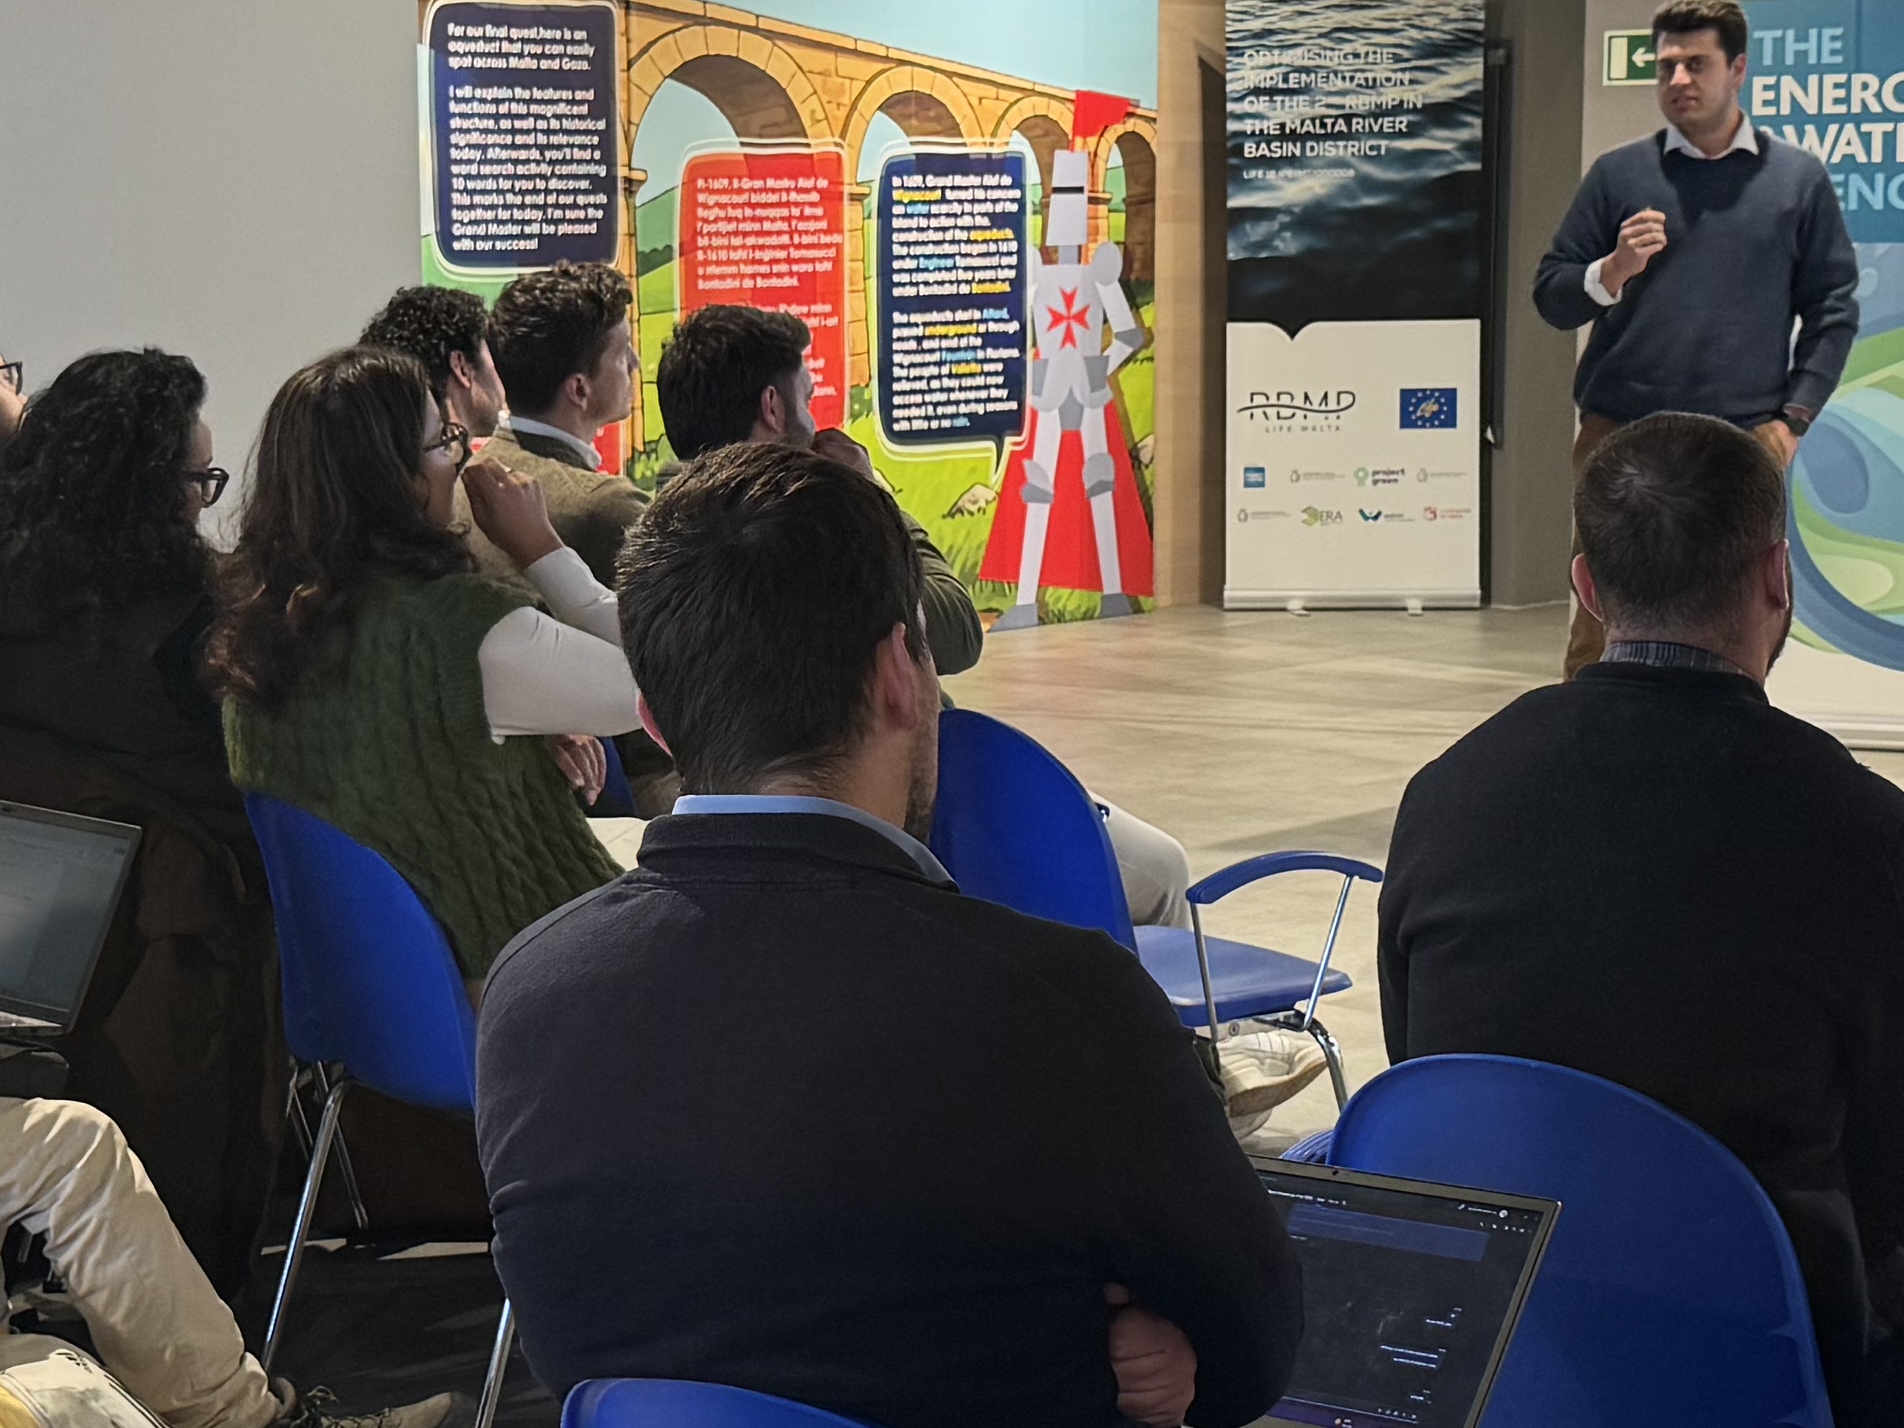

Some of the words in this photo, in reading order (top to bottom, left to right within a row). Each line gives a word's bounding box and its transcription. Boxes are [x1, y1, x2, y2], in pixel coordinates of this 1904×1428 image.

[448, 23, 464, 37] For
[448, 41, 500, 55] aqueduct
[501, 41, 521, 54] that
[523, 43, 543, 55] you
[545, 45, 565, 55] can
[566, 44, 595, 57] easily
[1753, 27, 1844, 67] THE
[1359, 49, 1394, 64] THE
[508, 58, 538, 70] Malta
[539, 58, 560, 70] and
[561, 58, 591, 70] Gozo.
[1244, 71, 1410, 89] IMPLEMENTATION
[474, 86, 513, 101] explain
[514, 87, 531, 99] the
[532, 87, 573, 99] features
[574, 88, 594, 100] and
[449, 102, 496, 114] functions
[498, 102, 508, 114] of
[510, 102, 528, 114] this
[529, 104, 588, 116] magnificent
[1244, 97, 1269, 112] OF
[1273, 96, 1312, 112] THE
[1345, 95, 1401, 110] RBMP
[1403, 94, 1423, 109] IN
[449, 117, 498, 130] structure,
[499, 120, 512, 129] as
[513, 118, 534, 129] well
[536, 120, 548, 129] as
[561, 118, 606, 130] historical
[1245, 120, 1281, 135] THE
[1285, 118, 1348, 134] MALTA
[1352, 117, 1408, 133] RIVER
[450, 134, 513, 146] significance
[514, 133, 535, 144] and
[549, 134, 599, 145] relevance
[450, 149, 485, 162] today.
[486, 148, 543, 160] Afterwards,
[573, 148, 591, 160] find
[1244, 142, 1301, 158] BASIN
[1306, 141, 1389, 157] DISTRICT
[451, 163, 478, 175] word
[479, 164, 514, 175] search
[516, 164, 553, 176] activity
[554, 164, 607, 177] containing
[452, 179, 464, 190] 10
[466, 178, 497, 190] words
[499, 178, 513, 190] for
[514, 180, 534, 192] you
[536, 179, 546, 190] to
[548, 179, 592, 190] discover.
[451, 193, 470, 205] This
[472, 193, 504, 205] marks
[506, 193, 522, 205] the
[524, 193, 544, 205] end
[546, 193, 557, 205] of
[558, 194, 575, 204] our
[576, 193, 607, 206] quests
[451, 207, 496, 223] together
[498, 208, 511, 220] for
[513, 208, 546, 222] today.
[547, 208, 564, 220] I'm
[565, 210, 585, 220] sure
[587, 208, 604, 220] the
[452, 223, 486, 236] Grand
[487, 223, 521, 235] Master
[523, 223, 540, 235] will
[542, 223, 556, 234] be
[557, 222, 597, 236] pleased
[452, 238, 474, 251] with
[476, 240, 493, 250] our
[1250, 391, 1356, 420] RBMP
[1371, 468, 1405, 477] project
[1371, 477, 1398, 486] green
